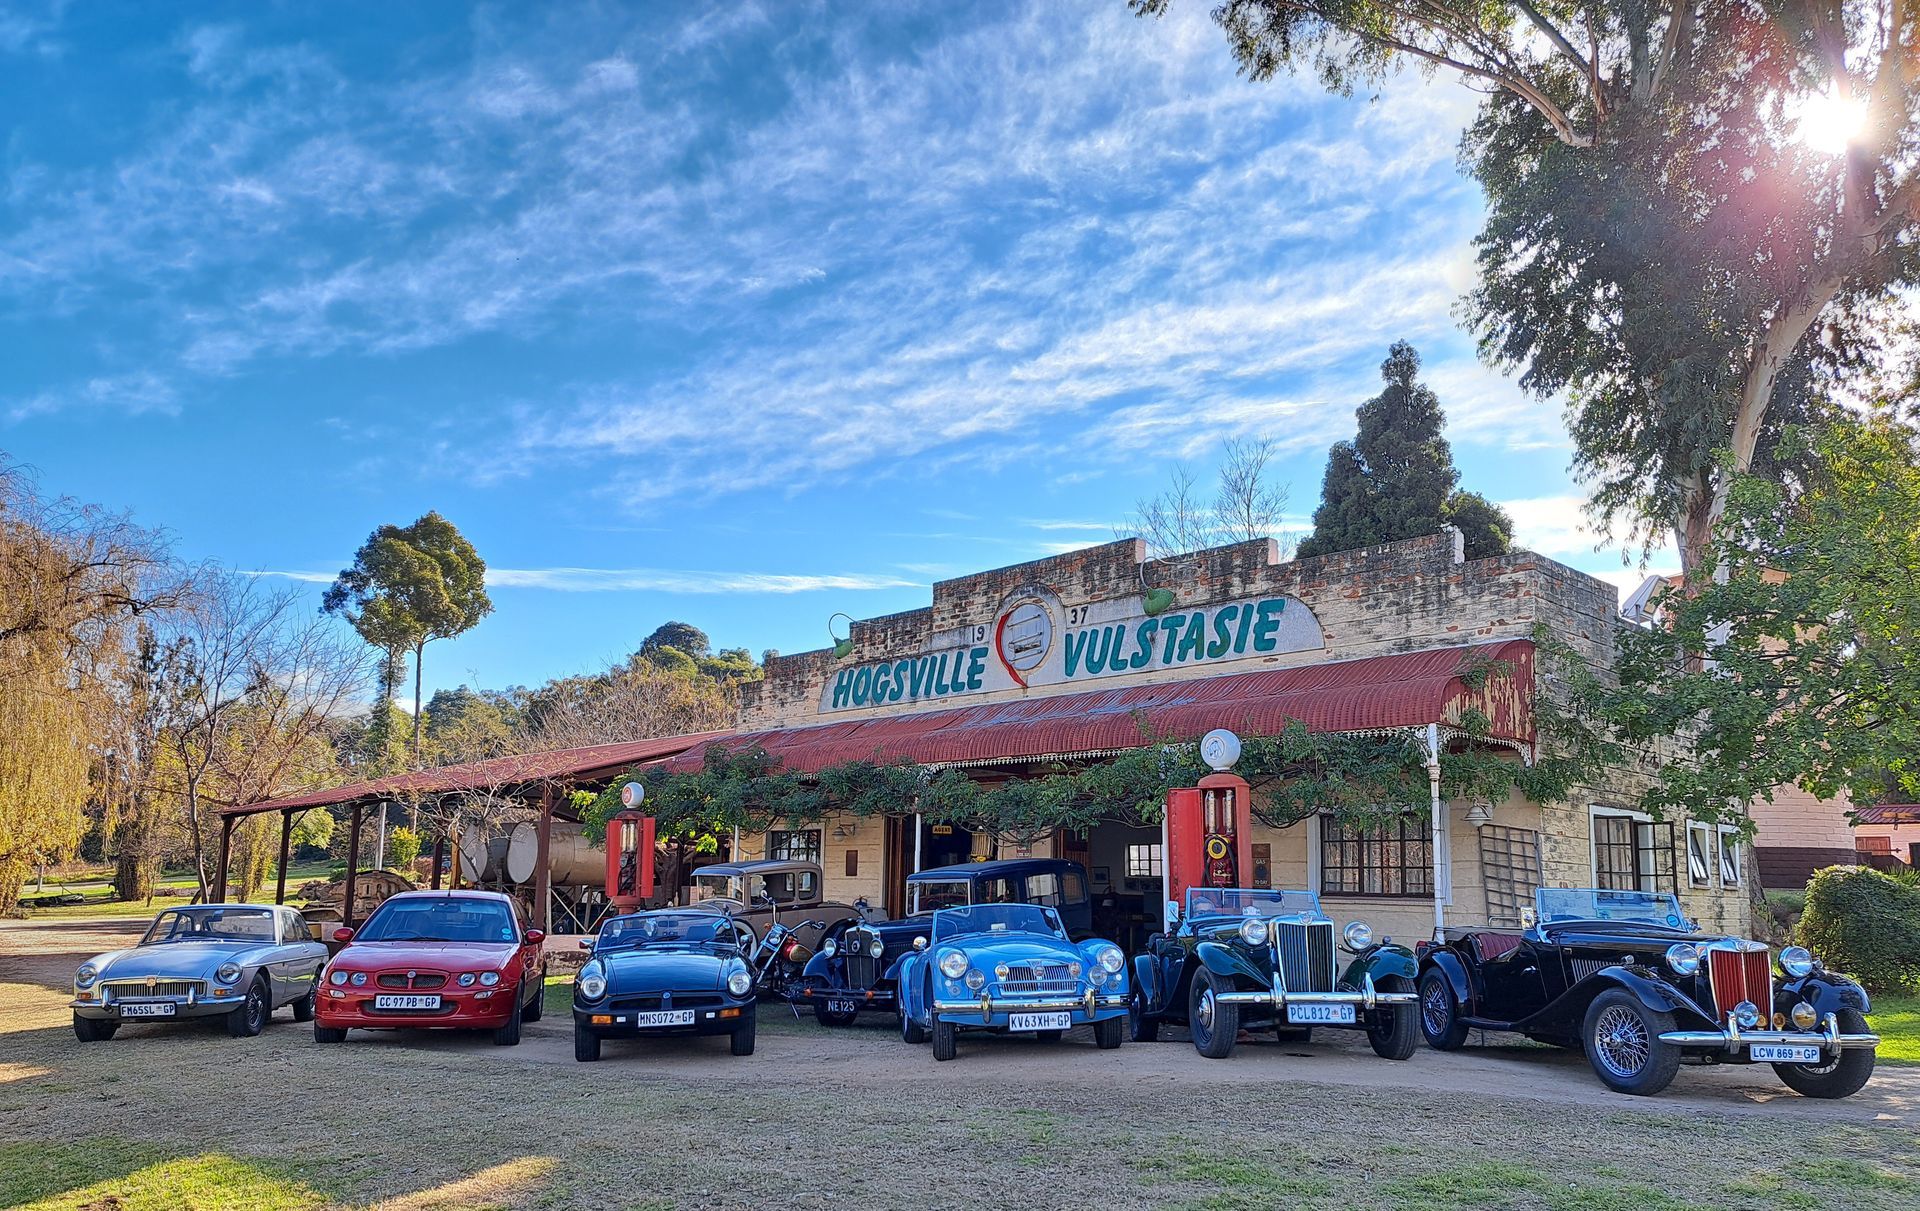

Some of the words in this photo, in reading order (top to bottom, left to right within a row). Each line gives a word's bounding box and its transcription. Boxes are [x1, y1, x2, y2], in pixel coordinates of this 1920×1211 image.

[972, 624, 985, 643] 19
[1070, 605, 1089, 625] 37
[832, 647, 989, 708] HOGSVILLE
[1065, 599, 1286, 677] VULSTASIE
[380, 997, 390, 1007] CC
[393, 997, 404, 1007] 97
[406, 997, 417, 1007] PB
[425, 997, 436, 1007] GP
[163, 1004, 174, 1014] GP
[1290, 1007, 1331, 1020] PCL812
[1340, 1007, 1353, 1020] GP
[682, 1011, 693, 1022] GP
[1011, 1015, 1050, 1028] KV63XH
[1057, 1014, 1070, 1026] GP
[1753, 1047, 1775, 1058] LCW
[1776, 1048, 1793, 1059] 869
[1803, 1048, 1817, 1059] GP
